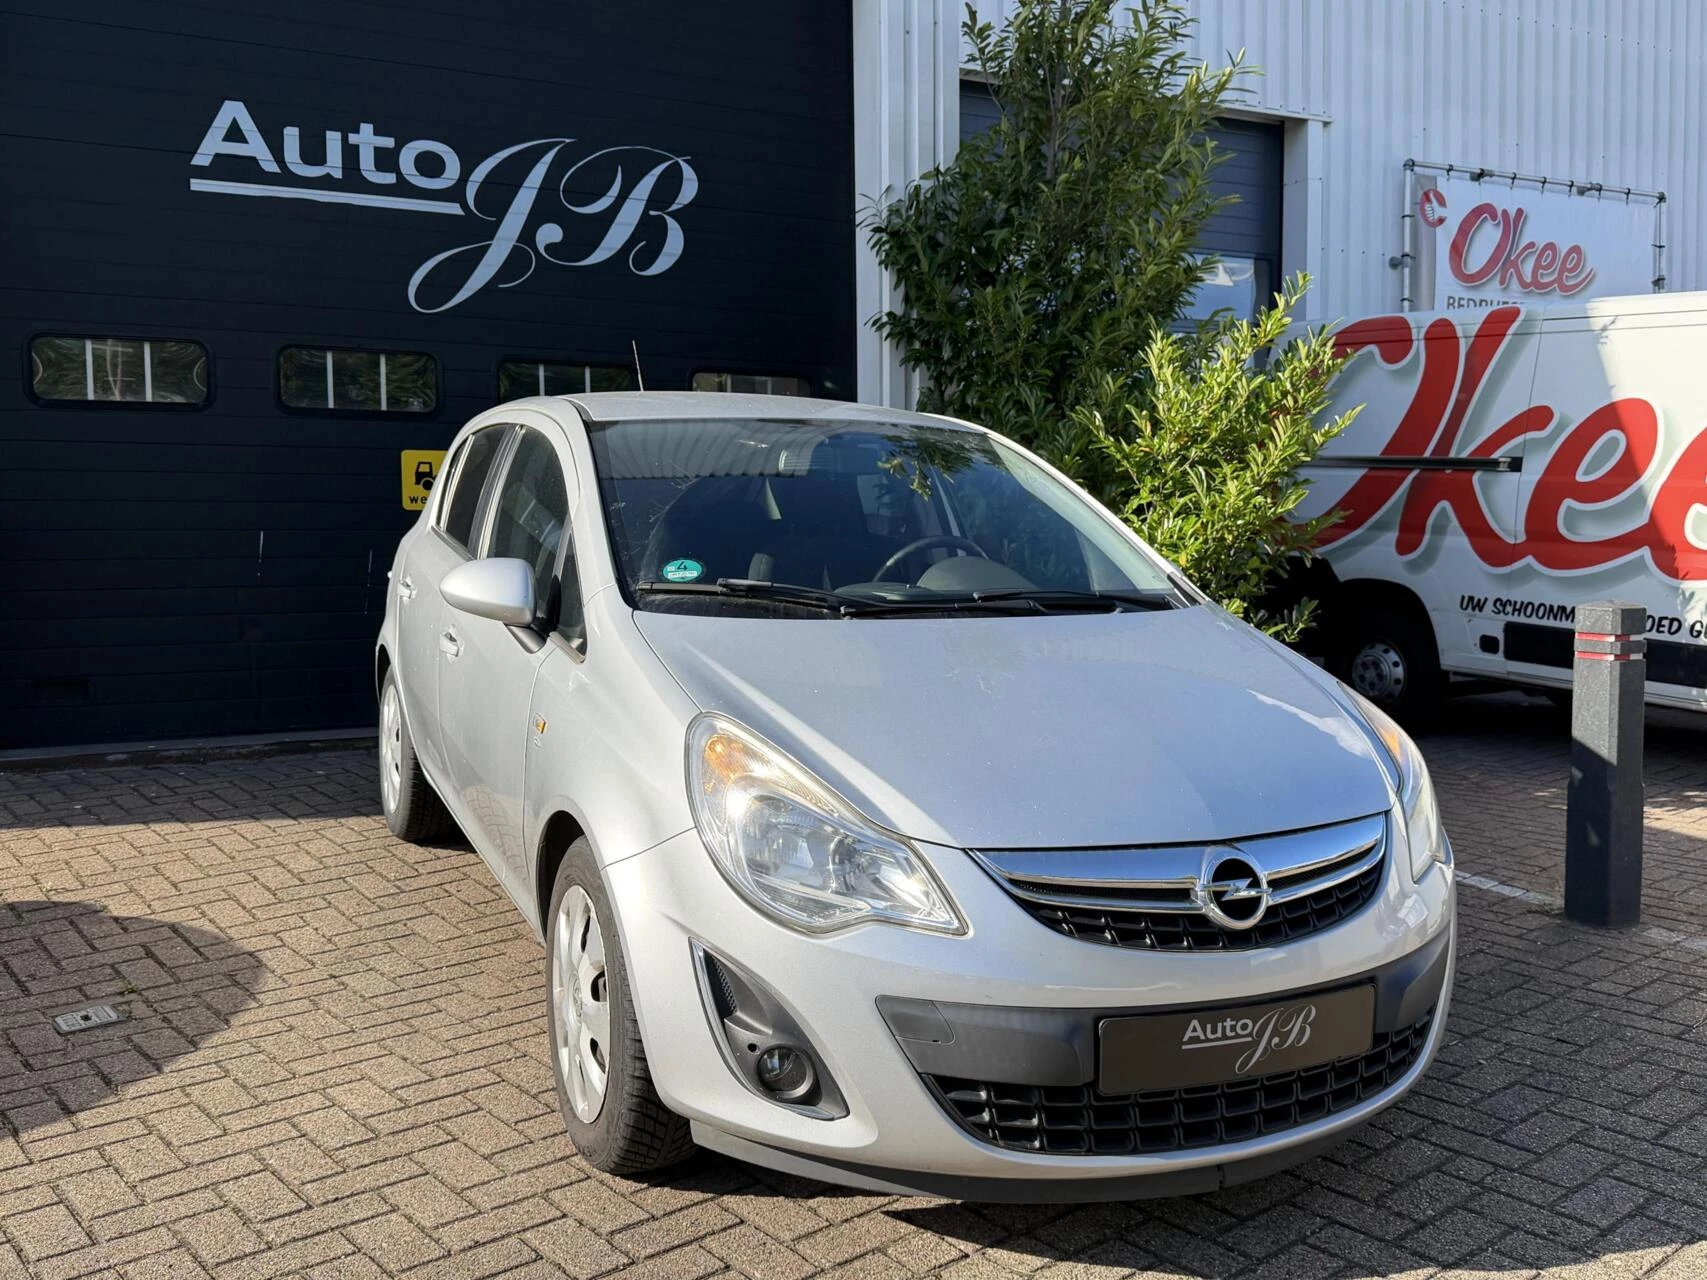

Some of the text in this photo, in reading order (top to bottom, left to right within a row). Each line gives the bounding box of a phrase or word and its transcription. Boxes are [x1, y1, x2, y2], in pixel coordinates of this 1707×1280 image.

[190, 100, 461, 190] Auto
[1448, 202, 1594, 294] Okee
[1460, 595, 1488, 612] UW
[1491, 597, 1576, 623] SCHOONM
[1182, 1018, 1253, 1042] Auto
